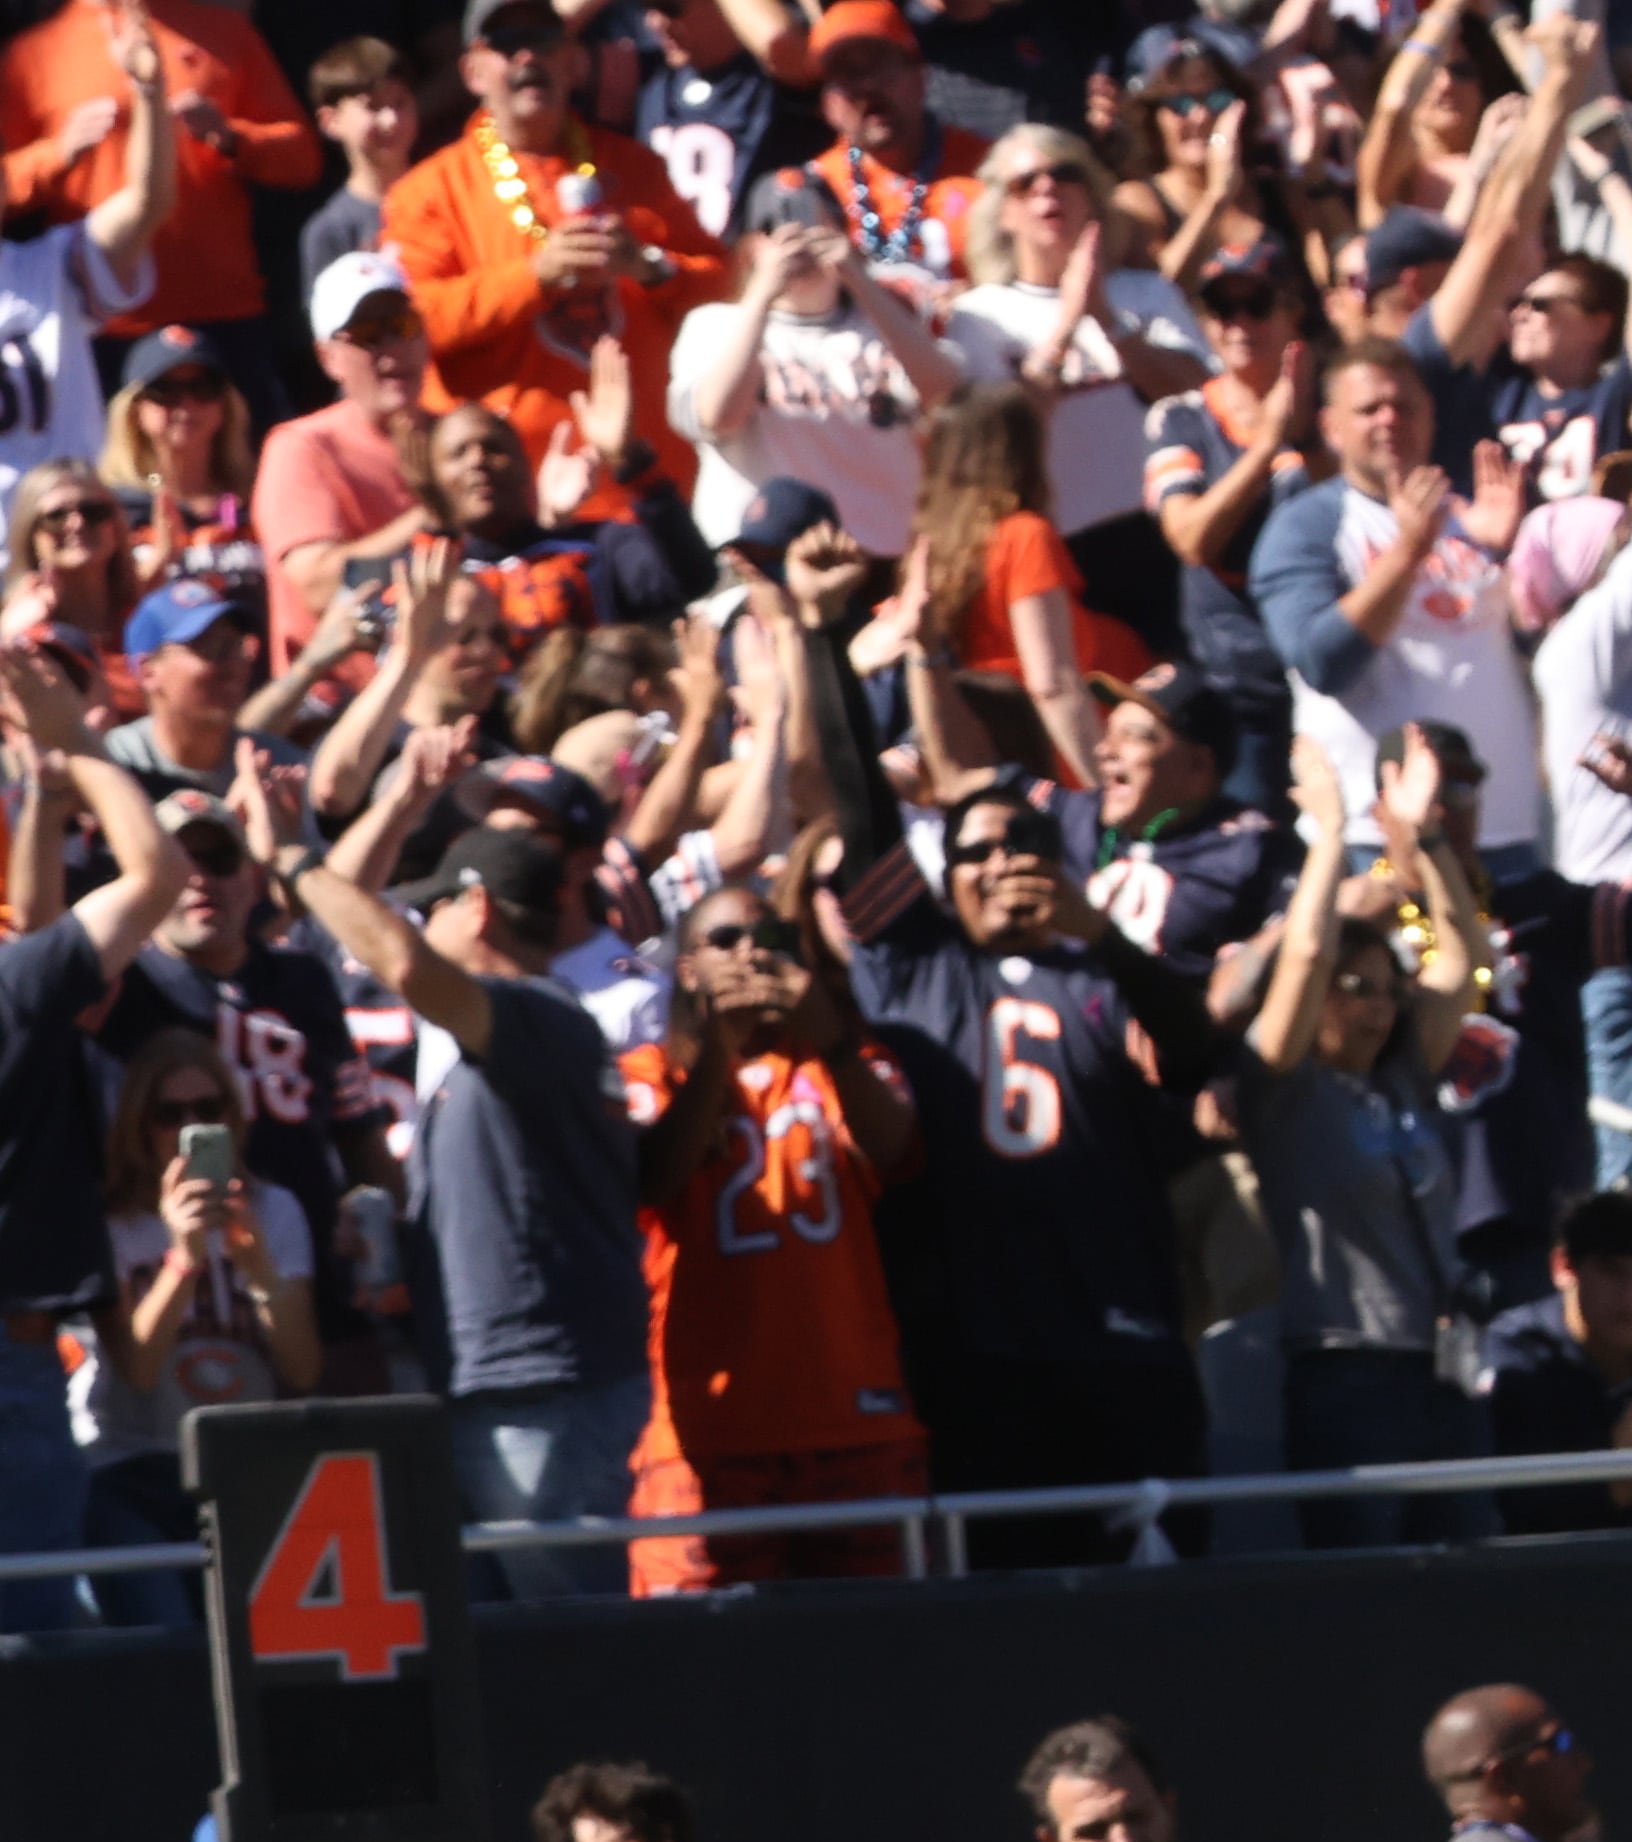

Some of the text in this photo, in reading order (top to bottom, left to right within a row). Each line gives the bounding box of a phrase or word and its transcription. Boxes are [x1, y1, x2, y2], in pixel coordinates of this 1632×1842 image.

[988, 997, 1063, 1160] 6
[714, 1102, 843, 1256] 23
[250, 1450, 428, 1684] 4
